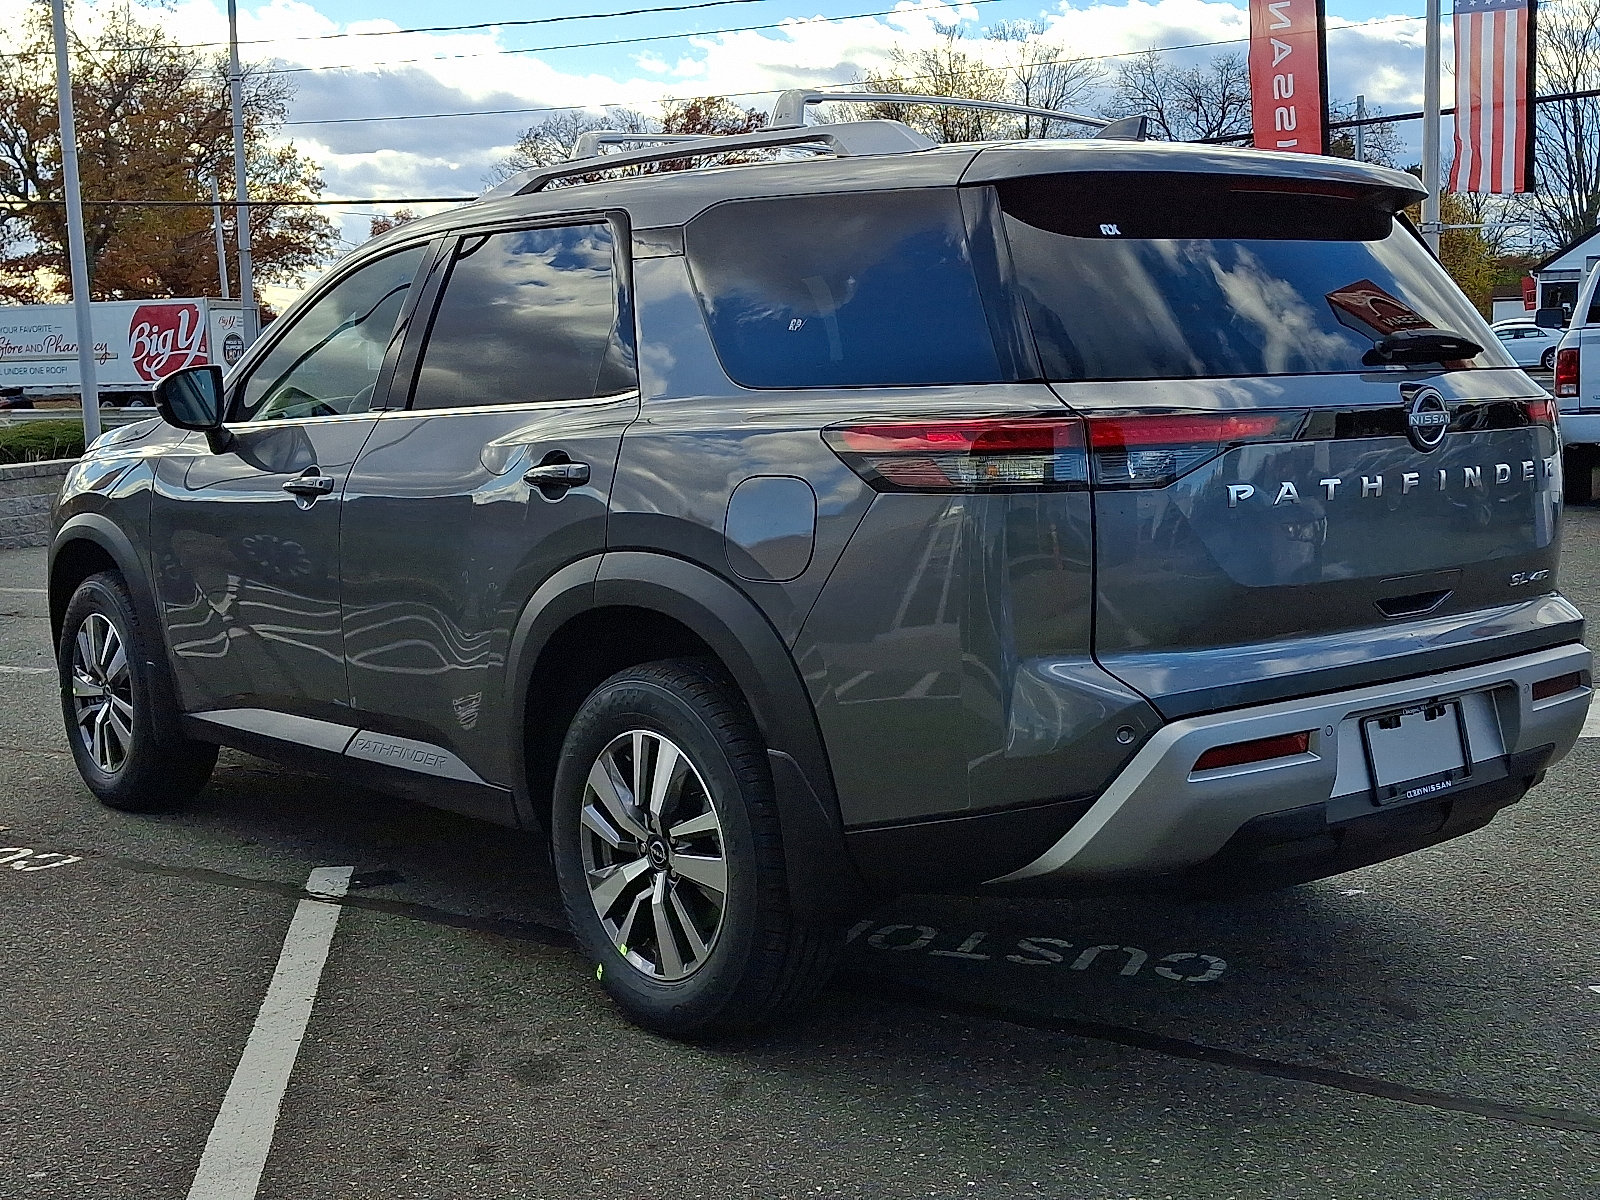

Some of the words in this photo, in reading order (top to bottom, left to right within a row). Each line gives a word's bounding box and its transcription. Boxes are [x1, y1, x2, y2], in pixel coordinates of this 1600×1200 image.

[19, 324, 52, 333] FAVORITE
[177, 307, 206, 371] Y
[25, 343, 43, 352] AND
[43, 333, 110, 366] Pharcy
[3, 367, 28, 375] UNDER
[29, 366, 44, 375] ONE
[45, 365, 68, 374] ROOF!
[1410, 414, 1451, 425] NISSAN
[1226, 457, 1555, 508] PATHFINDER
[353, 738, 448, 769] PATHFINDER
[1422, 780, 1452, 795] NISSAN
